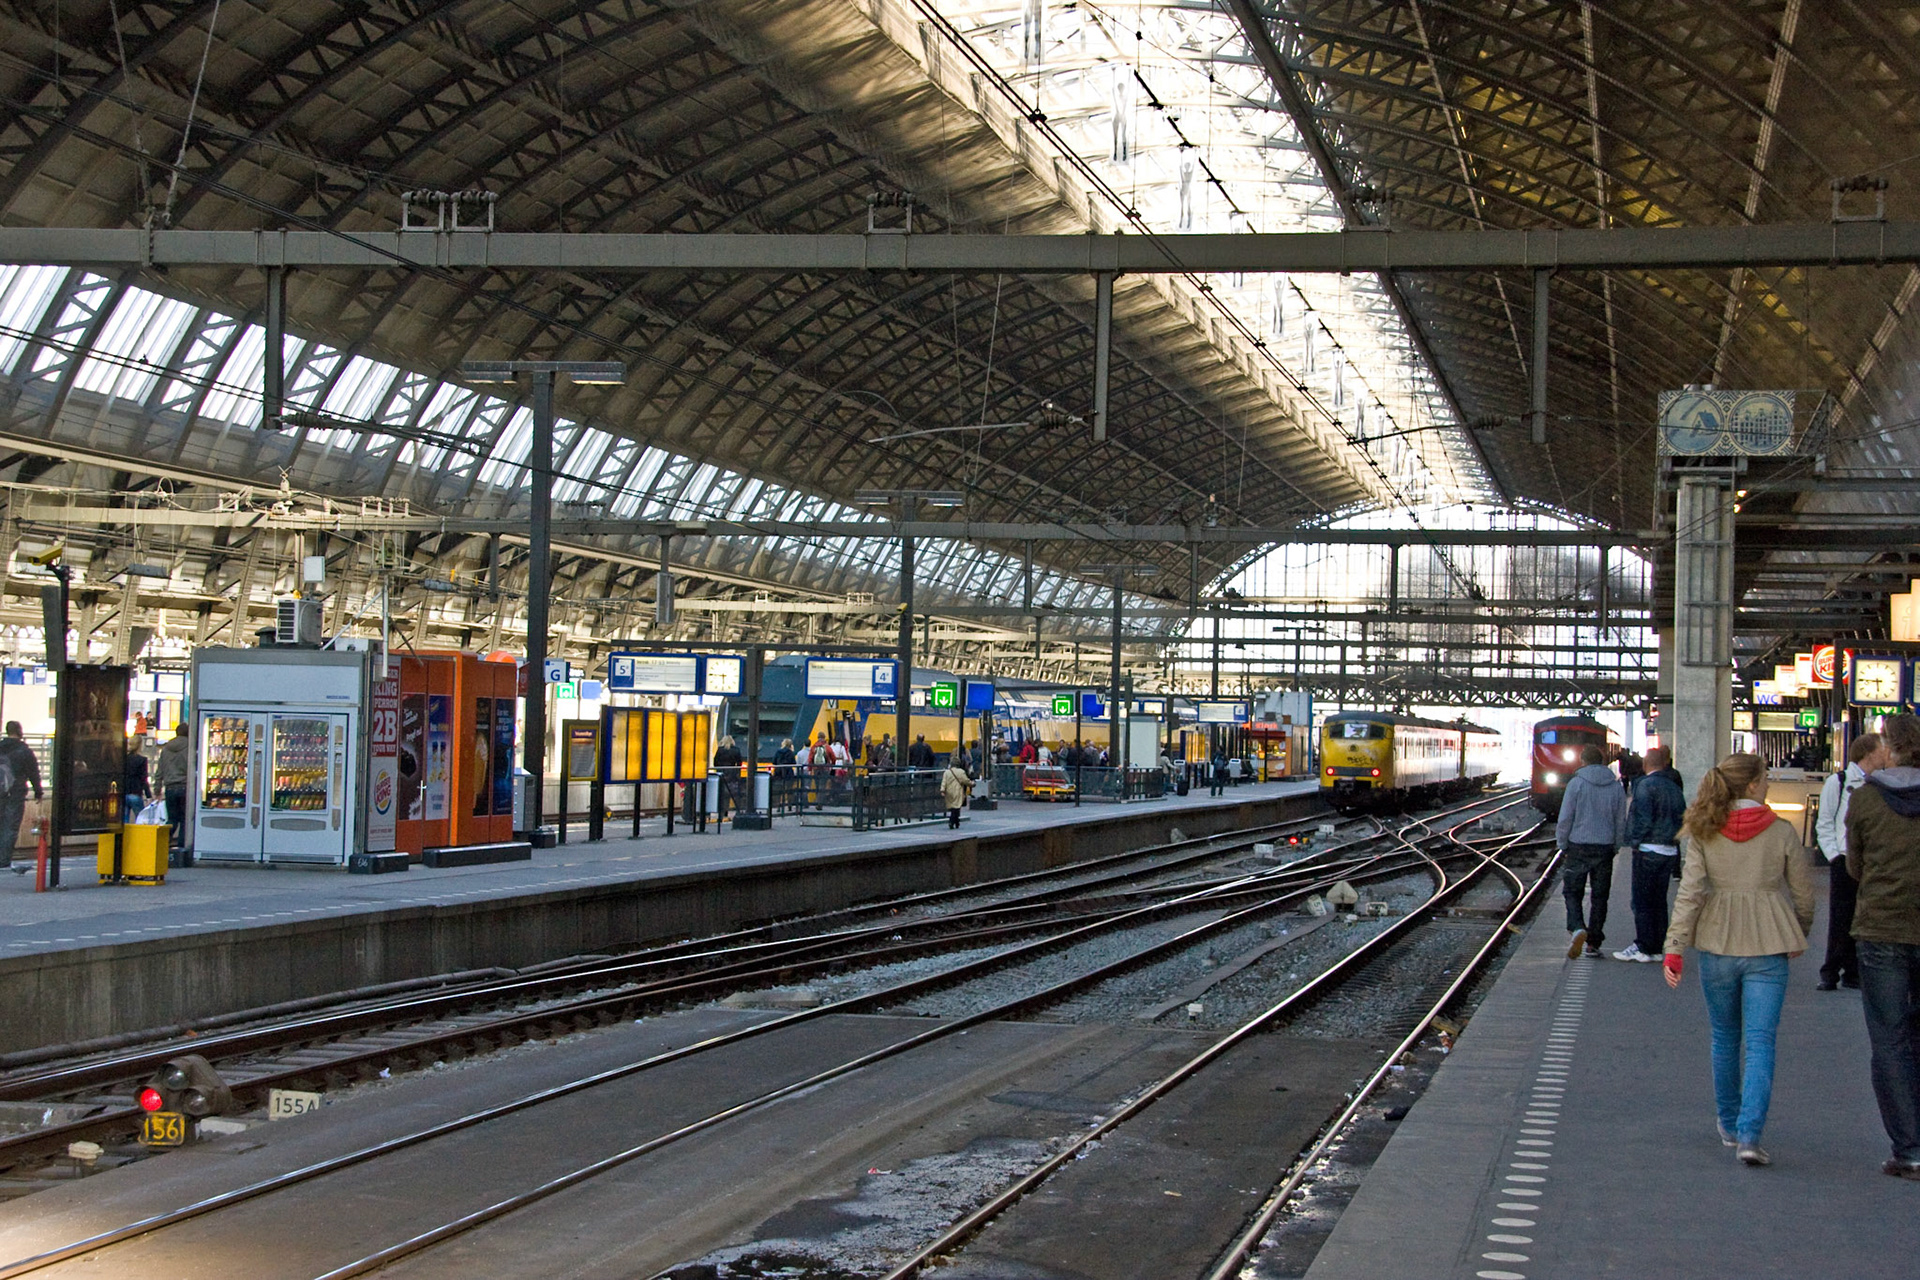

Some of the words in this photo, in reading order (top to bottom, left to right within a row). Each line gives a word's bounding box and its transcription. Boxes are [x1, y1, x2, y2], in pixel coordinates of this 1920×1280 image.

[550, 669, 560, 681] G
[374, 681, 398, 697] KING
[1757, 694, 1779, 705] WC
[374, 710, 397, 743] 2B
[145, 1116, 179, 1141] 156
